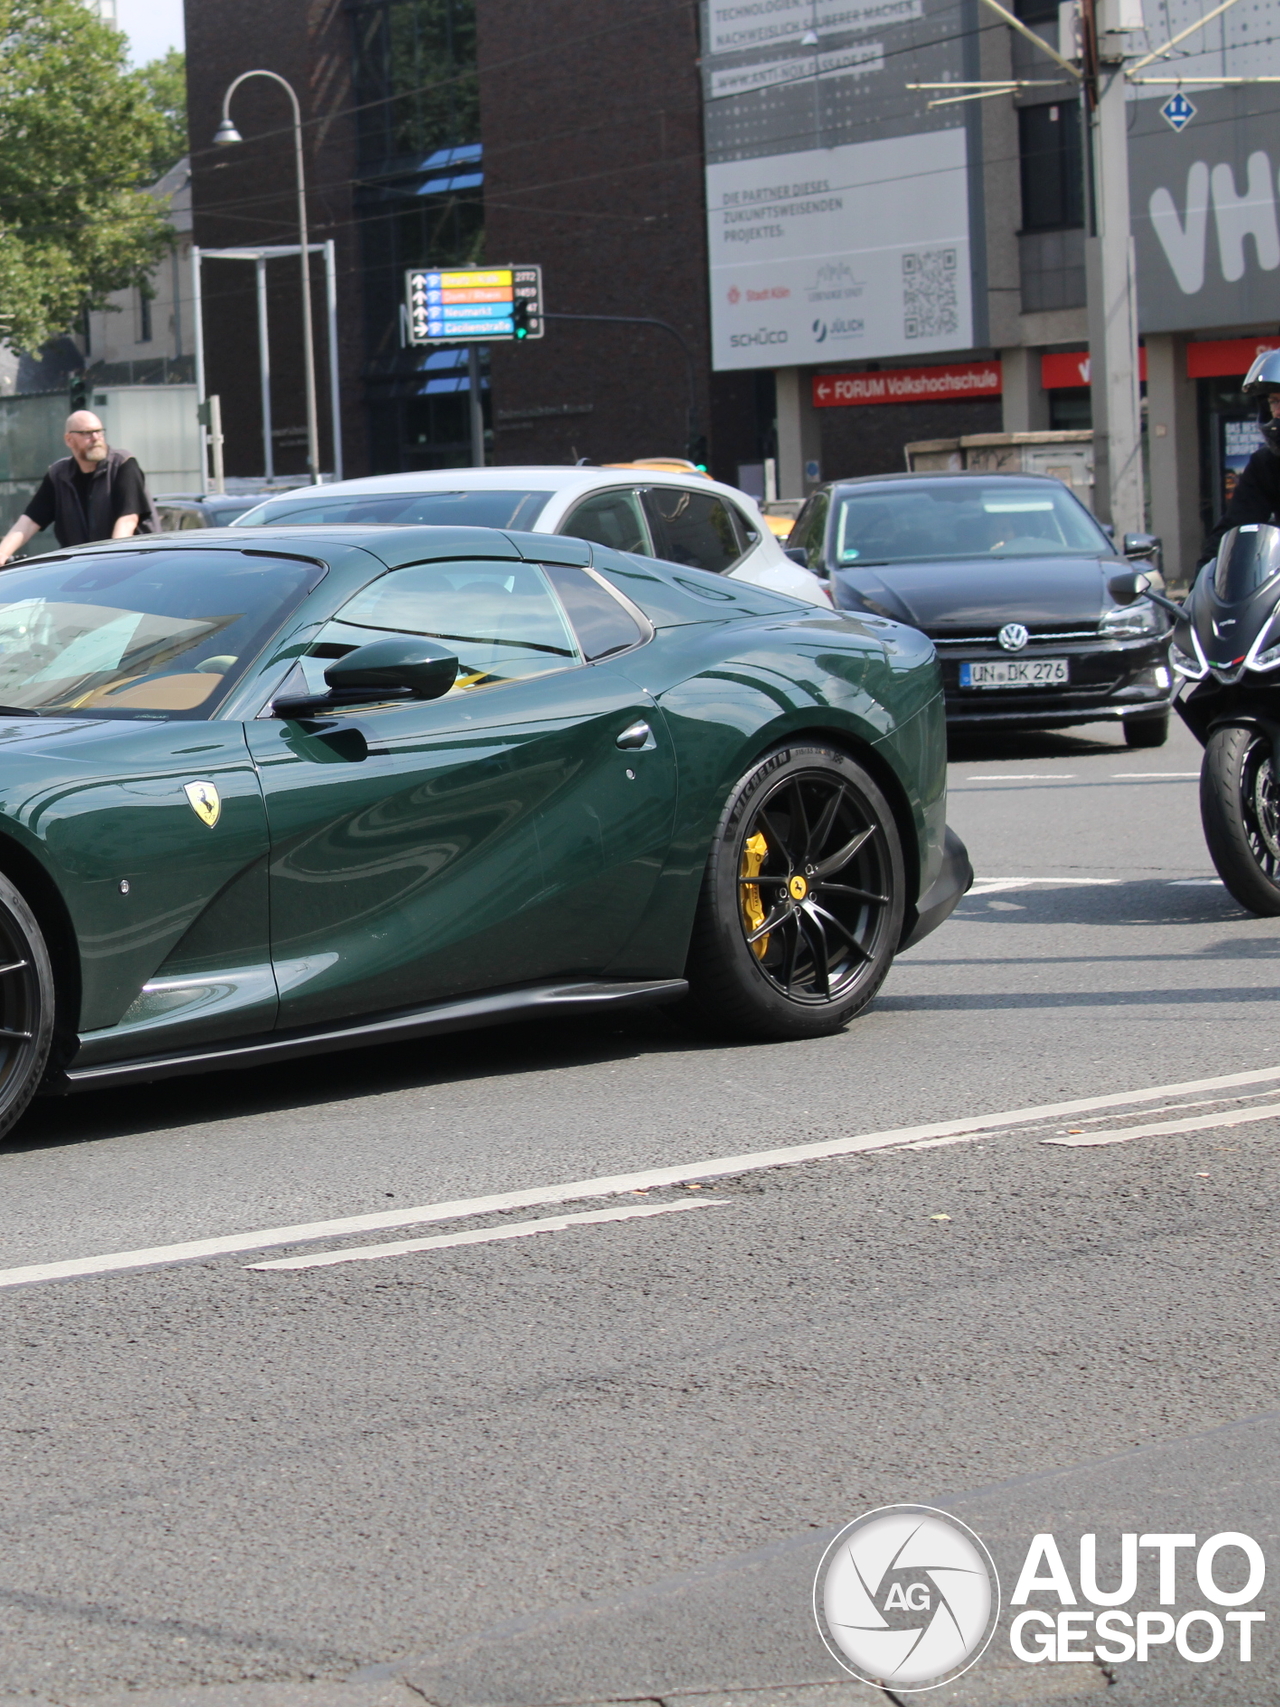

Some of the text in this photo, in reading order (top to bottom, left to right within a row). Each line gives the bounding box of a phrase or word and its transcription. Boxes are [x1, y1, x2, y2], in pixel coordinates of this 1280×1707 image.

[723, 180, 830, 205] DIE PARTNER DIESES
[724, 198, 843, 224] ZUKUNFTSWEISENDEN
[1149, 150, 1280, 294] VH
[445, 306, 492, 317] Neumarkt
[445, 320, 511, 333] Cäcilienstraße
[730, 328, 788, 347] SCHÜCO
[830, 318, 864, 335] JÜLICH
[835, 370, 997, 398] FORUM Volkshochschule
[973, 662, 1065, 682] UN DK 276
[733, 751, 788, 820] MICHELIN
